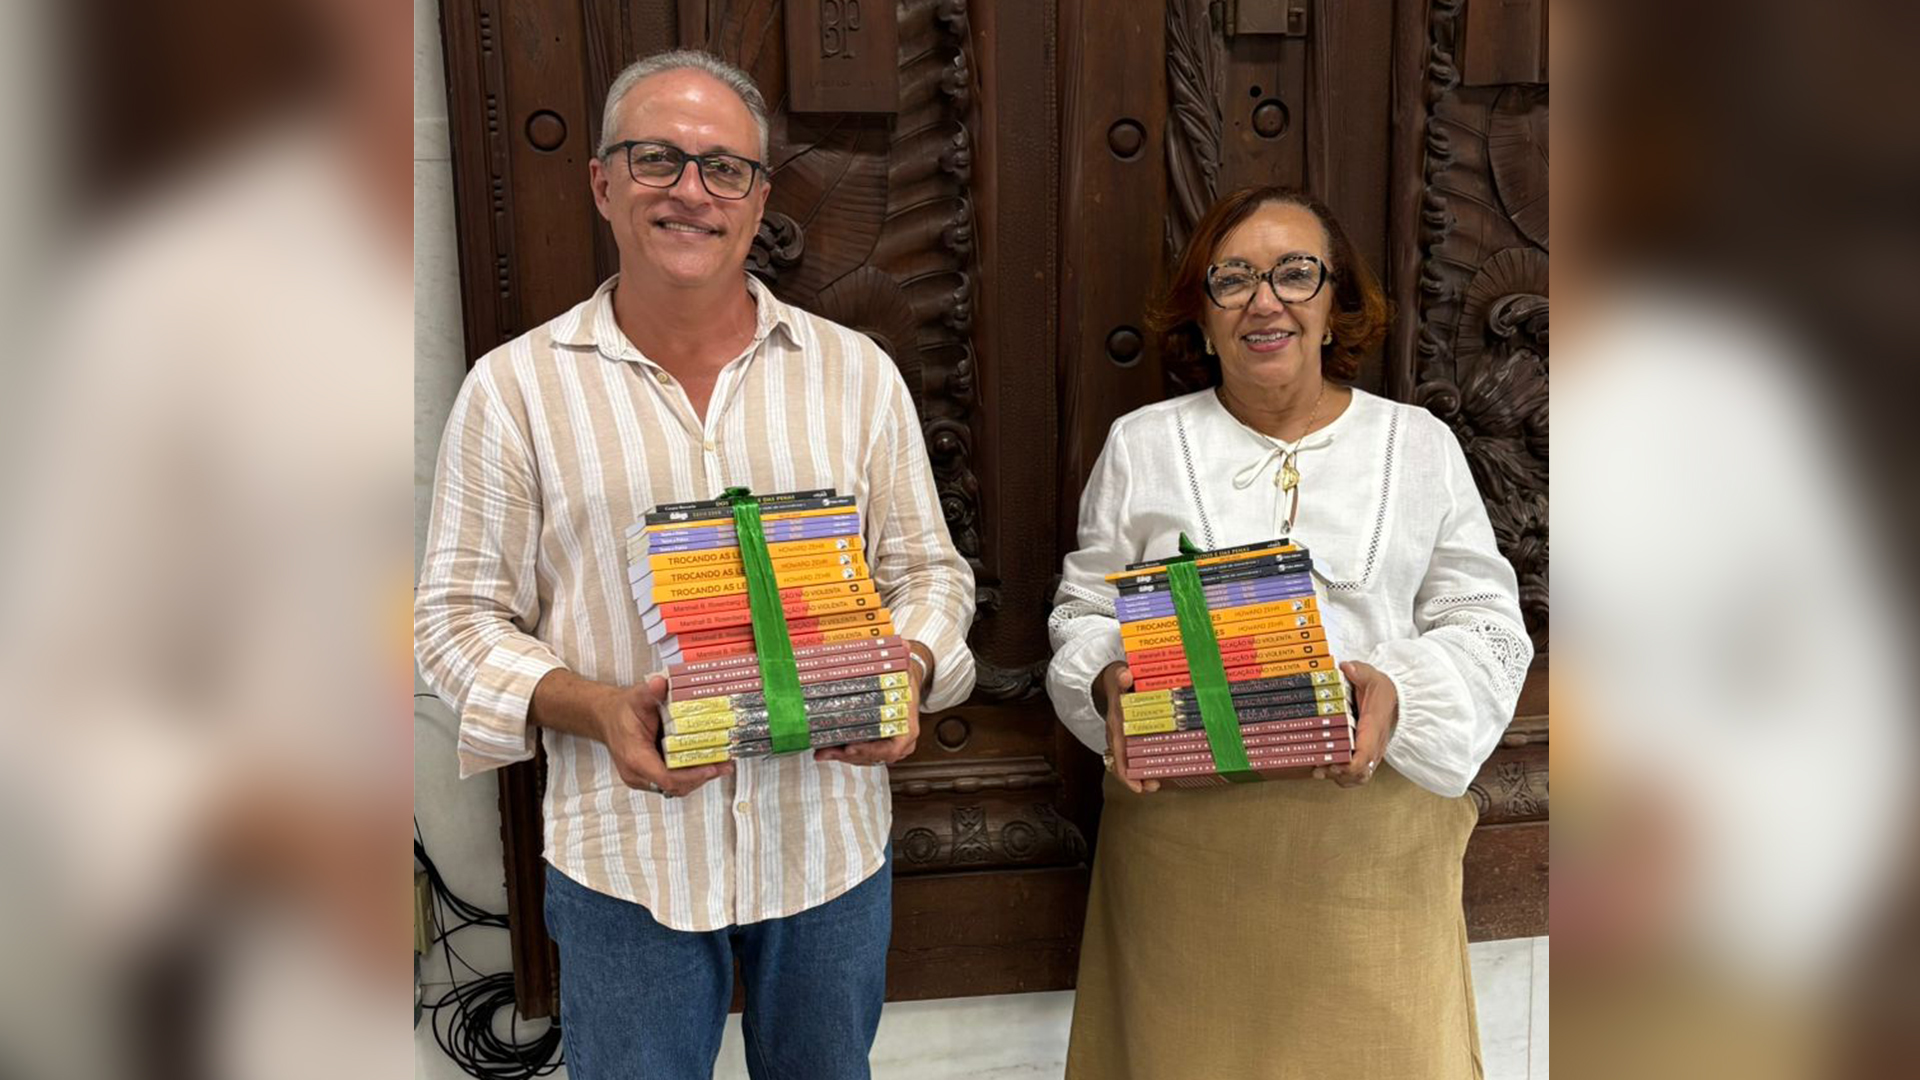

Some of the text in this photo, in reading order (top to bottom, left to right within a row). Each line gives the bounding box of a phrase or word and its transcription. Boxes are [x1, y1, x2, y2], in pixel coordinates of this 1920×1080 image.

[668, 554, 718, 566] TROCANDO
[718, 552, 731, 560] AS
[670, 570, 720, 582] TROCANDO
[722, 568, 734, 576] AS
[670, 584, 721, 597] TROCANDO
[811, 587, 841, 596] VIOLENTA
[818, 602, 848, 610] VIOLENTA
[827, 616, 857, 624] VIOLENTA
[1136, 621, 1178, 632] TROCANDO
[832, 632, 862, 640] VIOLENTA
[1139, 635, 1182, 646] TROCANDO
[1262, 634, 1292, 644] VIOLENTA
[1264, 649, 1295, 658] VIOLENTA
[1270, 663, 1300, 672] VIOLENTA
